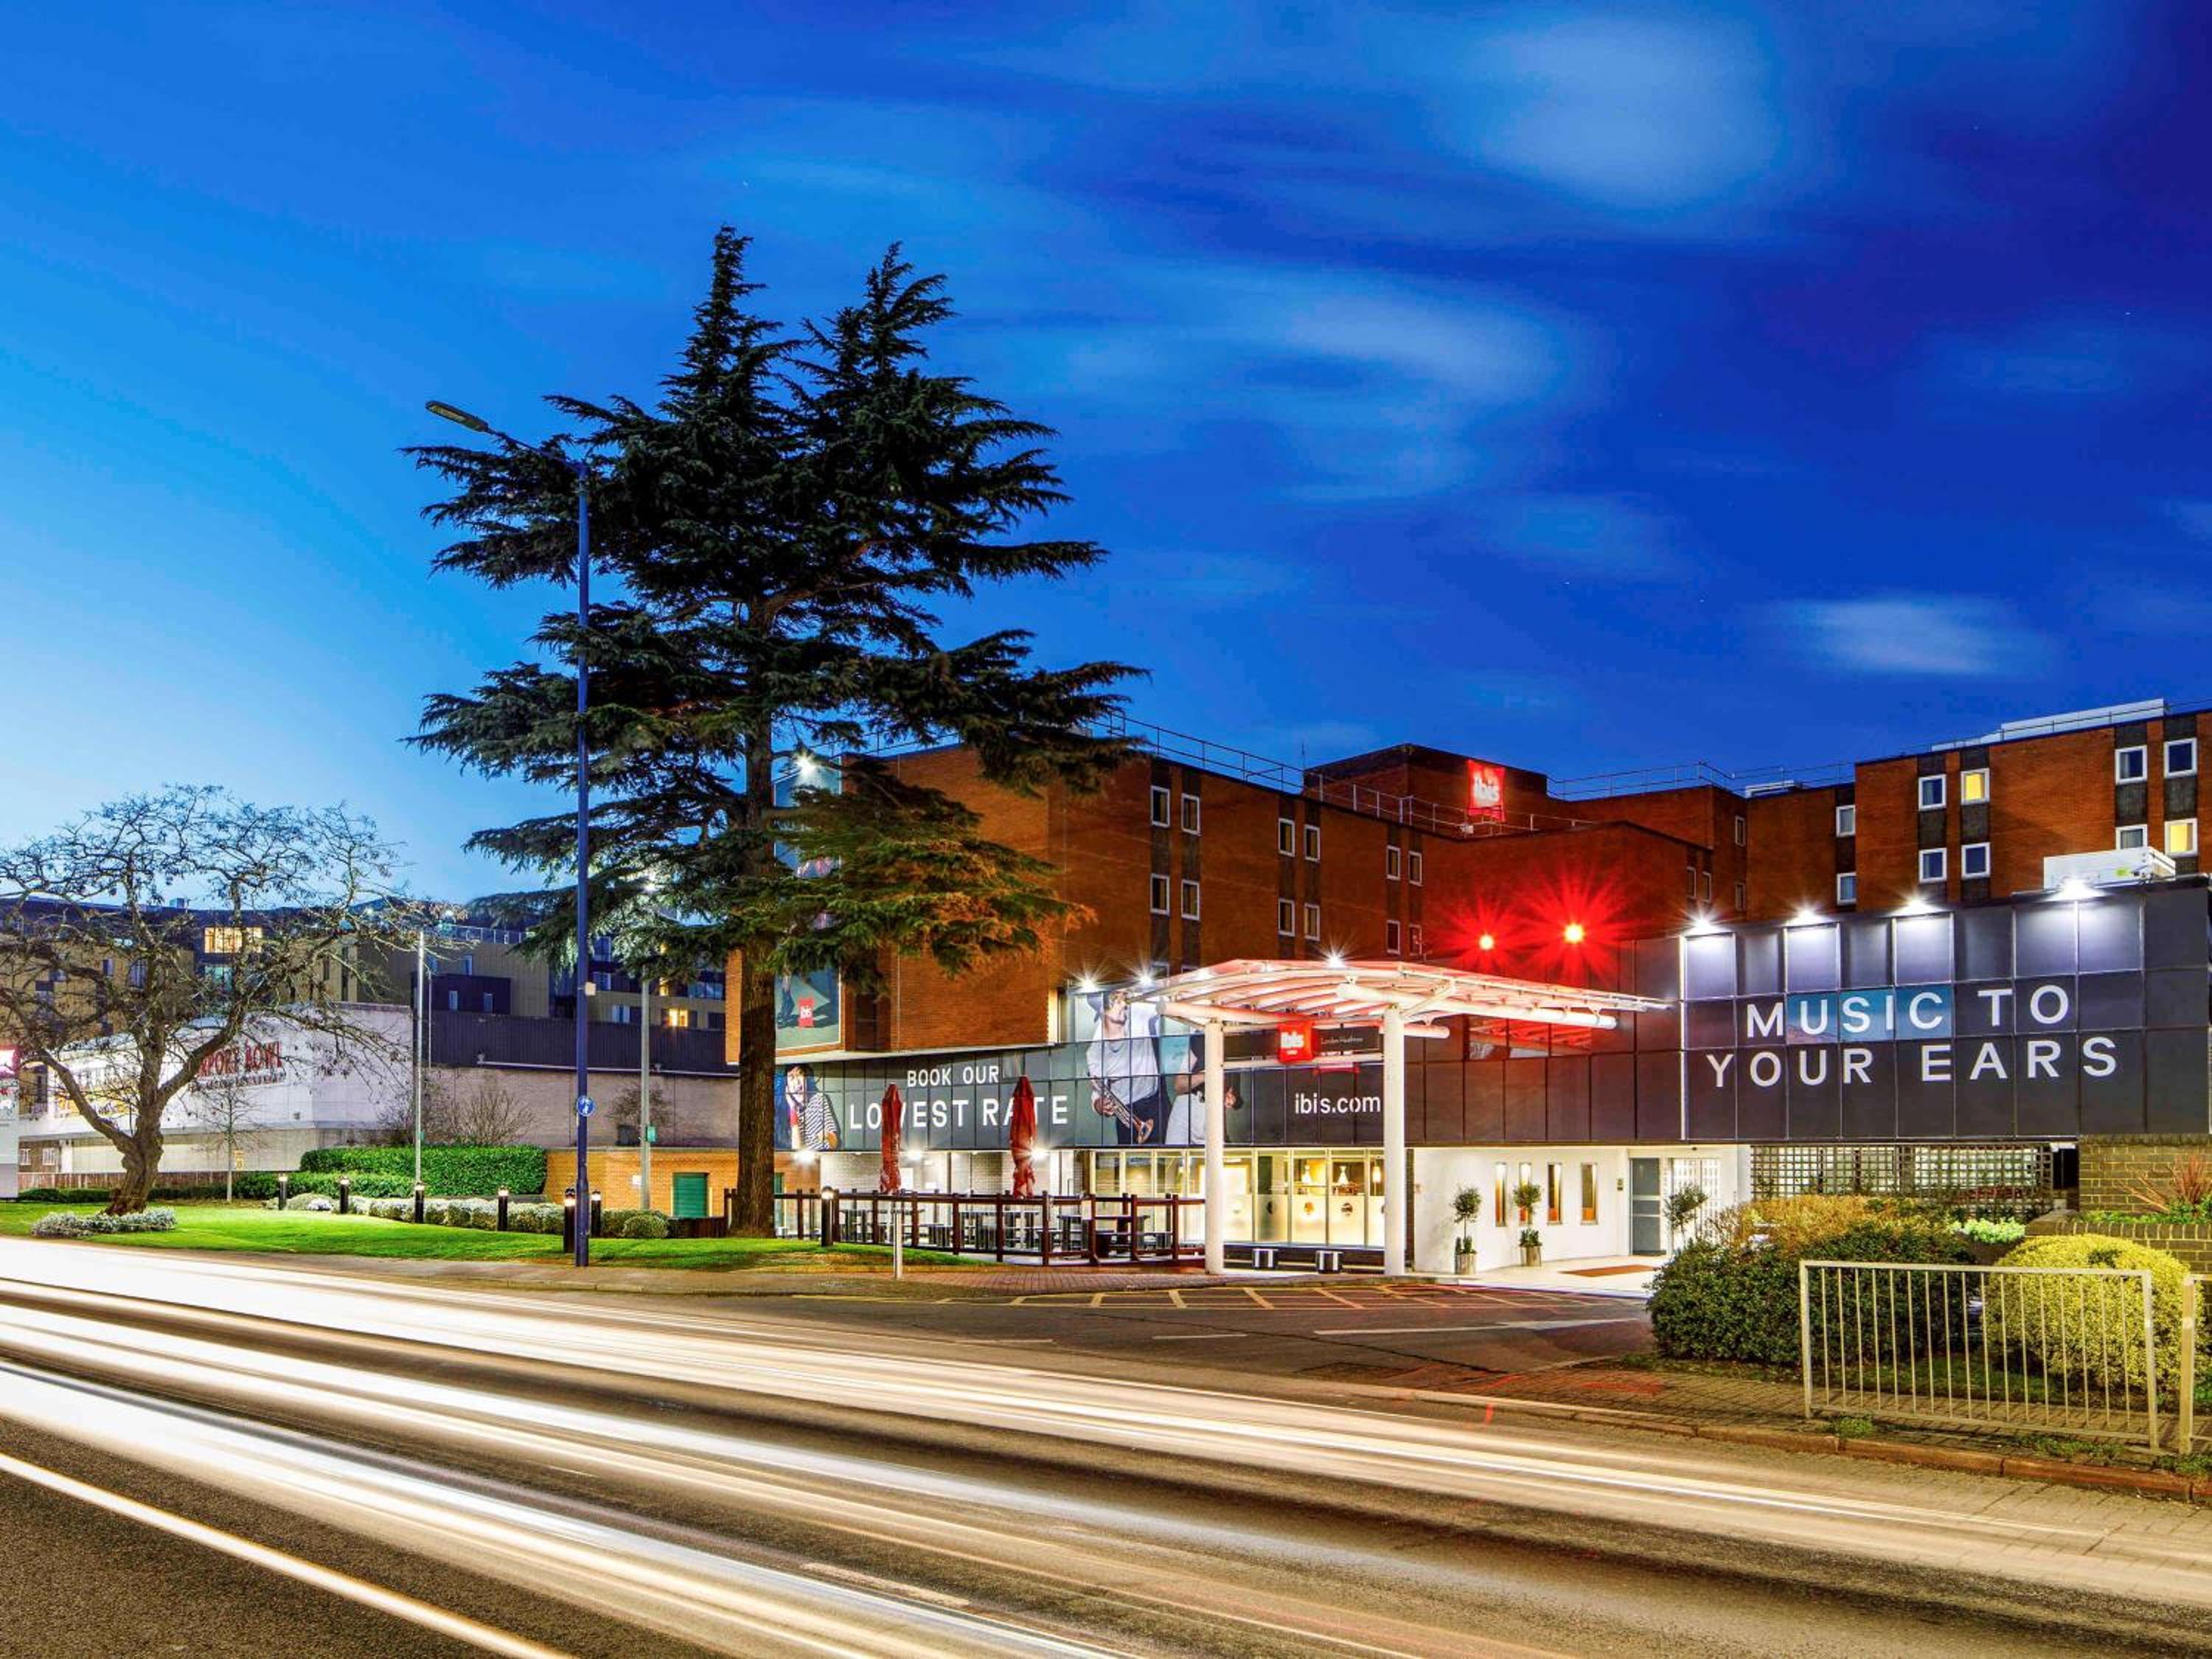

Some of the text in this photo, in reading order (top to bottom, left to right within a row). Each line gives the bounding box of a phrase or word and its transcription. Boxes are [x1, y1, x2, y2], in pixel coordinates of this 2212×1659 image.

[1746, 984, 2070, 1038] MUSIC TO
[907, 1065, 999, 1088] BOOK OUR
[1705, 1037, 2118, 1088] YOUR EARS
[849, 1099, 969, 1130] LOEST
[1295, 1092, 1381, 1114] ibis.com
